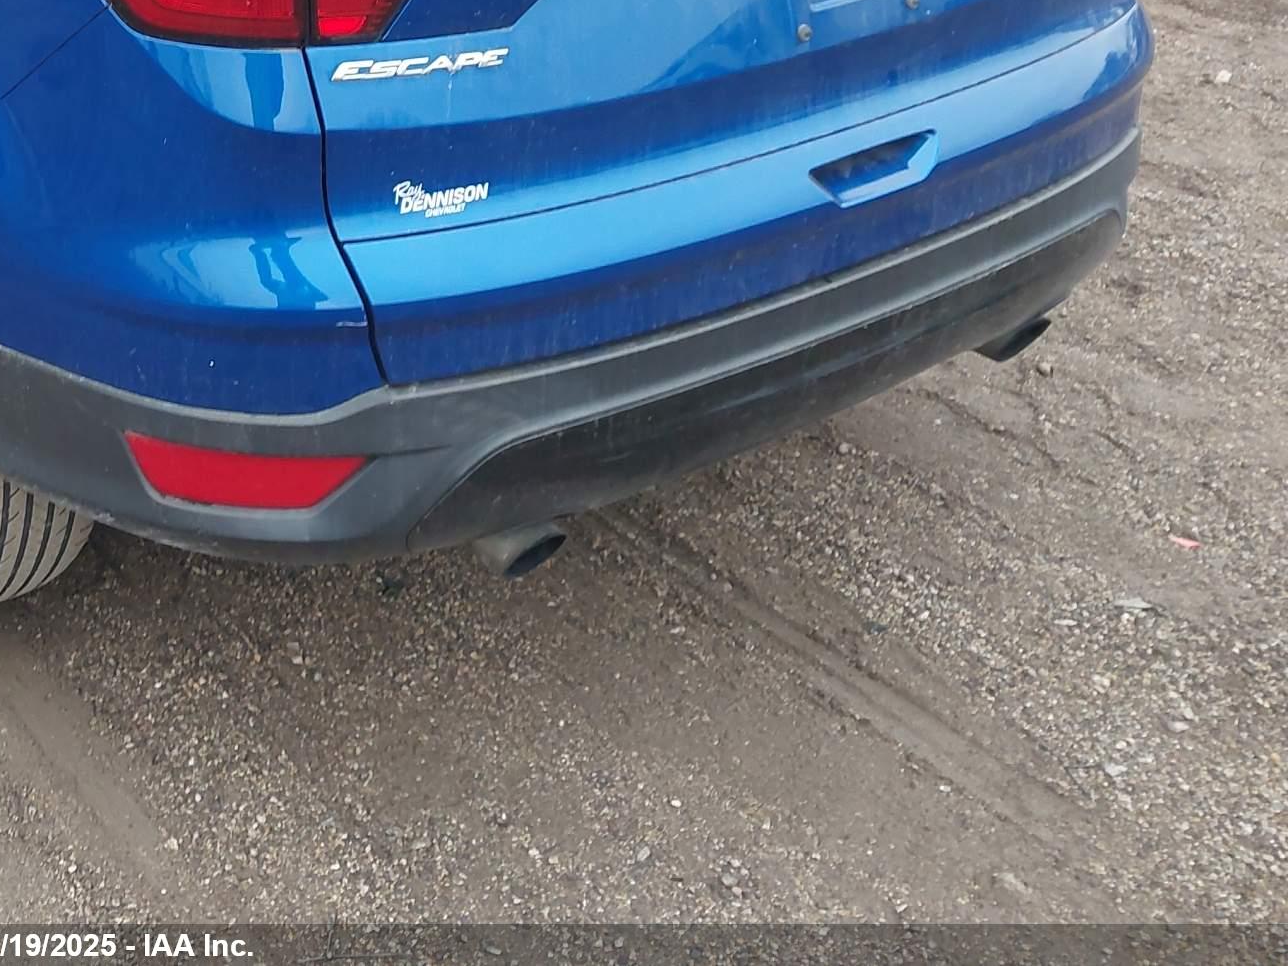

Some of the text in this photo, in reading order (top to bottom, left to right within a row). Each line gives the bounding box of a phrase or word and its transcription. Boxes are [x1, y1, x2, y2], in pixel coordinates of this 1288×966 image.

[330, 47, 510, 82] ESCAPE
[392, 180, 426, 206] Ray
[399, 182, 490, 215] DENNISON
